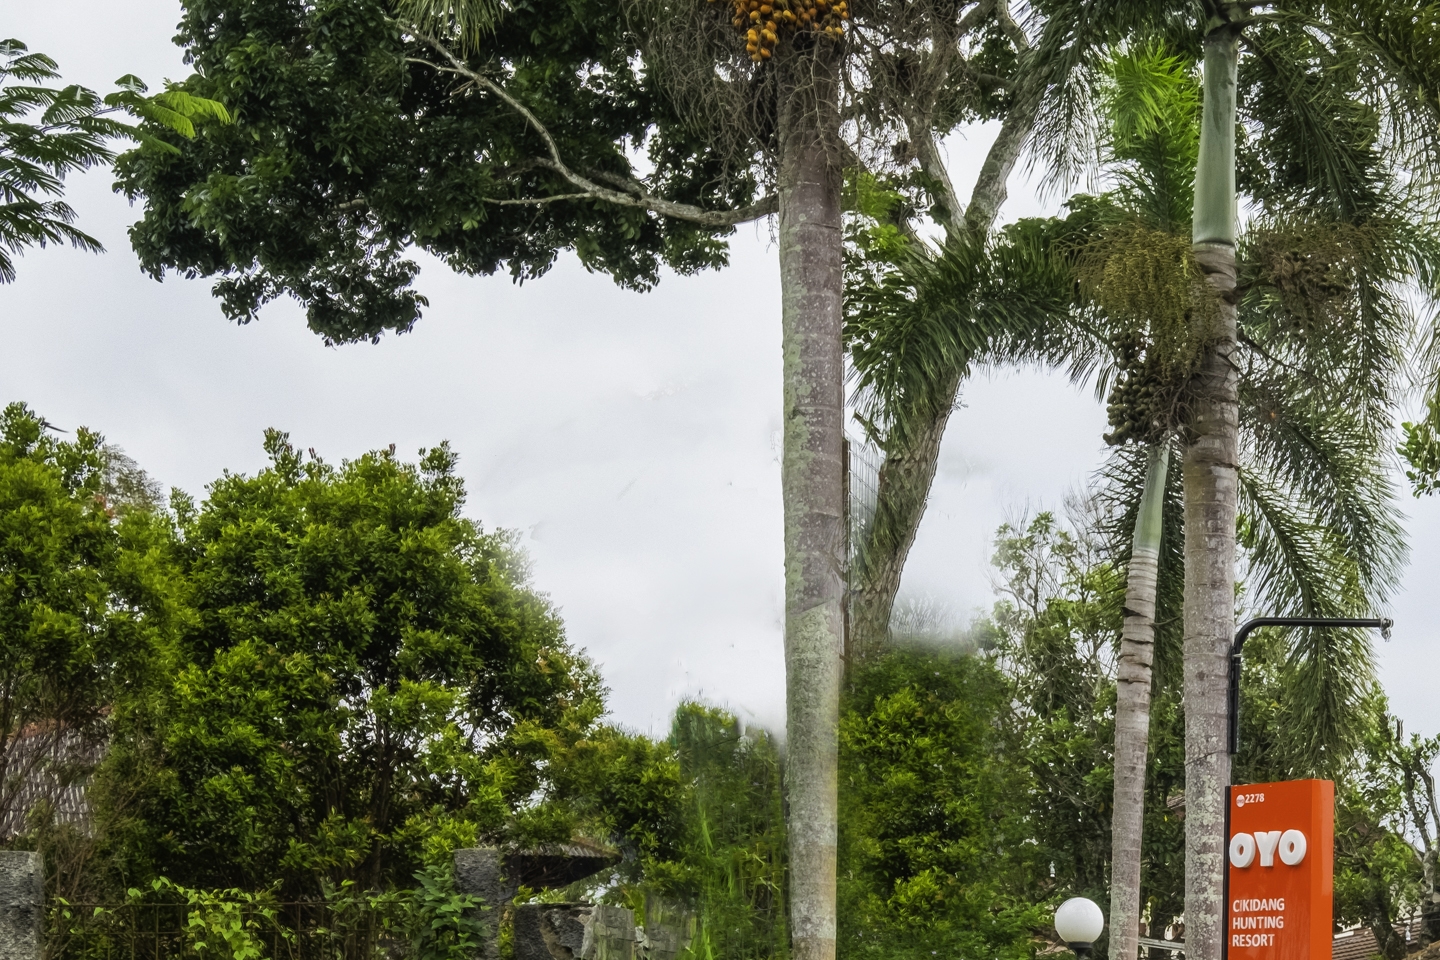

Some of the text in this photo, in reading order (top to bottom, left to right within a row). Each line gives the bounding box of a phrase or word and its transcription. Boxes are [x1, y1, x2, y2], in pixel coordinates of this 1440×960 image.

[1245, 793, 1265, 803] 2278
[1229, 829, 1307, 868] OYO
[1232, 898, 1285, 912] CIKIDANG
[1232, 916, 1284, 930] HUNTING
[1232, 934, 1275, 947] RESORT
